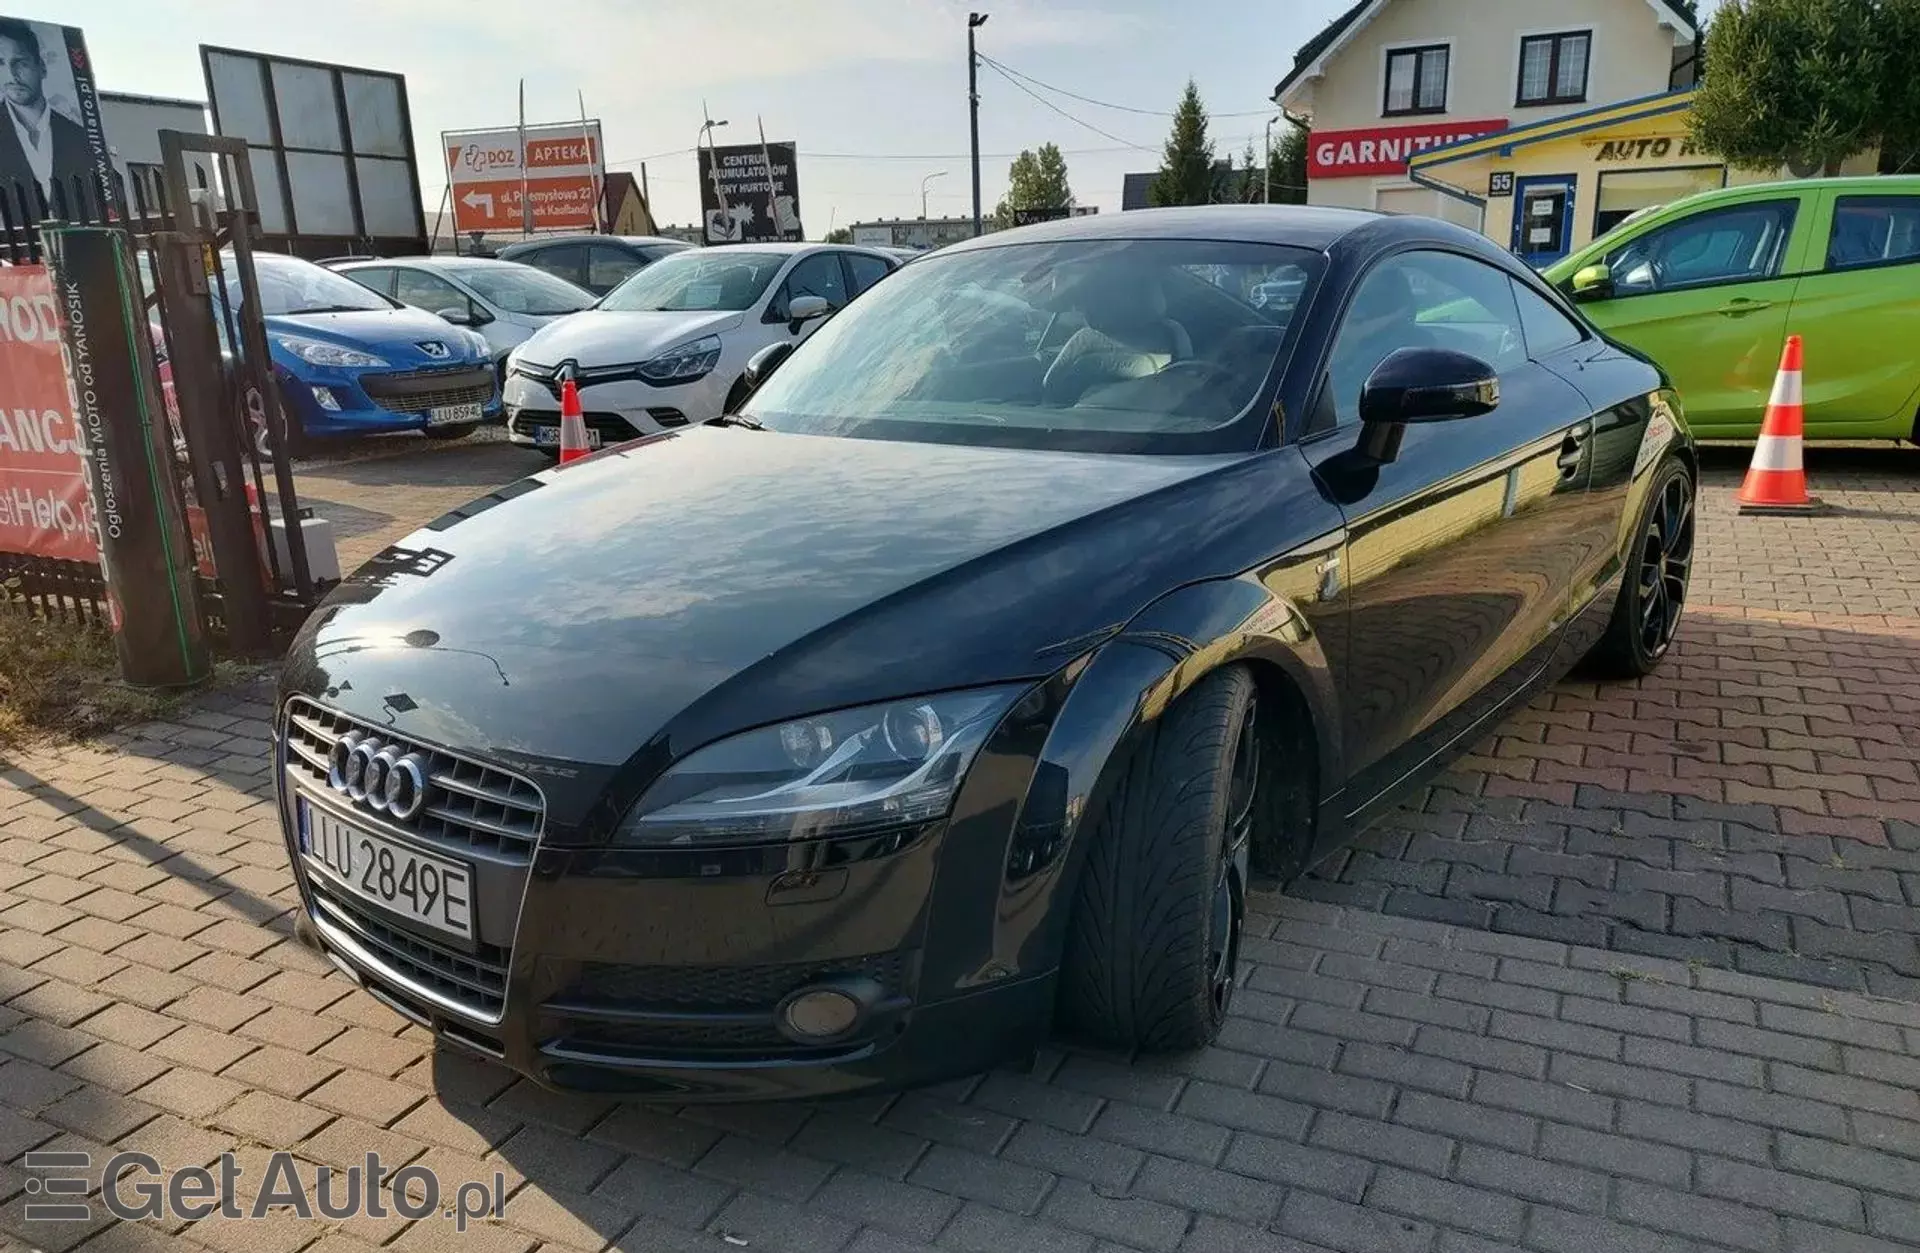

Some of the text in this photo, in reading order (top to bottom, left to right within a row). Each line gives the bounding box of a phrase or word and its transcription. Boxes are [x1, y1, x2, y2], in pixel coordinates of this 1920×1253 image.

[535, 144, 590, 161] APTEKA
[1316, 133, 1485, 165] GARNIT
[1595, 137, 1672, 161] AUTO
[1492, 174, 1511, 191] 55
[66, 282, 90, 360] YANOSIK
[79, 364, 95, 387] od
[84, 390, 105, 444] MOTO
[309, 808, 467, 931] LLU 2849E
